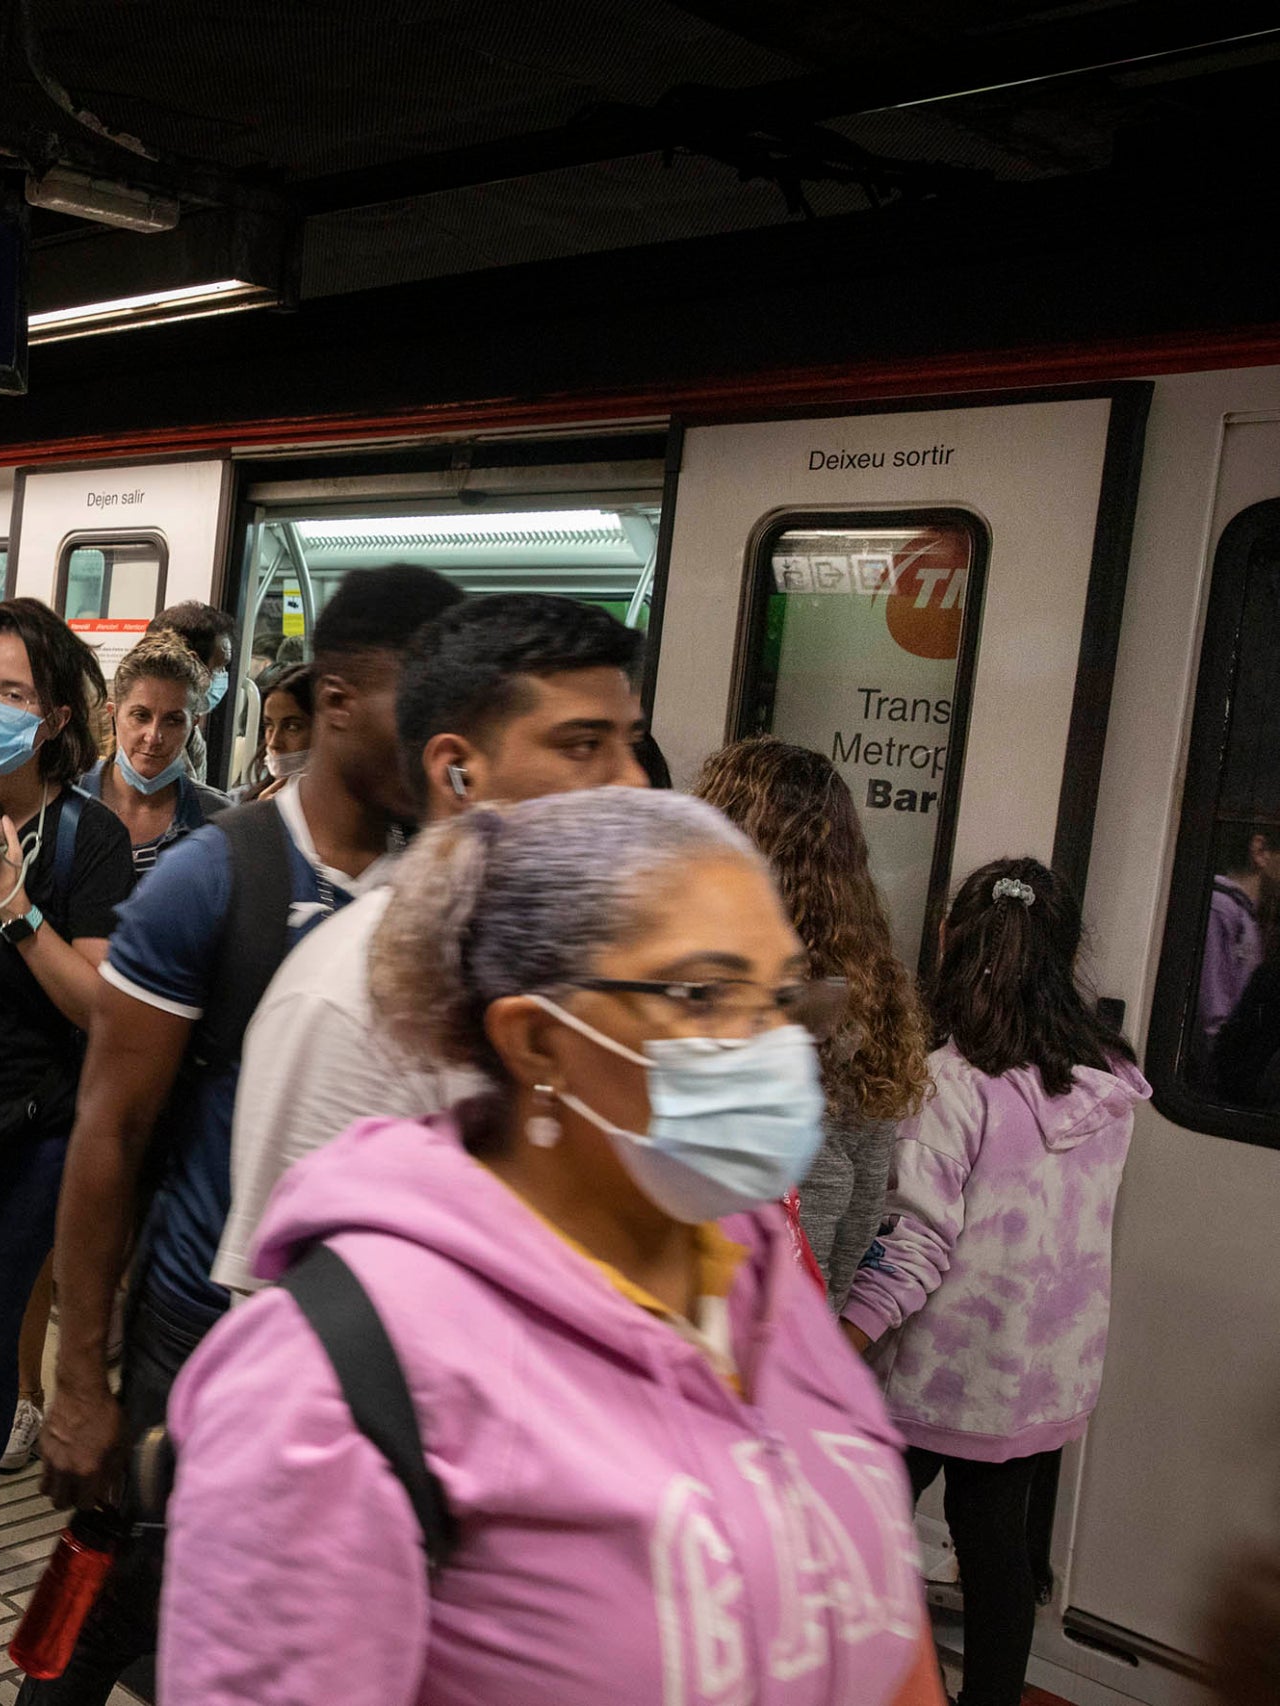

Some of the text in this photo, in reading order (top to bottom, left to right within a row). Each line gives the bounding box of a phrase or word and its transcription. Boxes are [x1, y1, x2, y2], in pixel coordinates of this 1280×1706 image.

[808, 443, 955, 471] Deixeu sortir
[86, 489, 146, 510] Dejen salir
[857, 688, 951, 725] Trans
[865, 778, 941, 813] Bar
